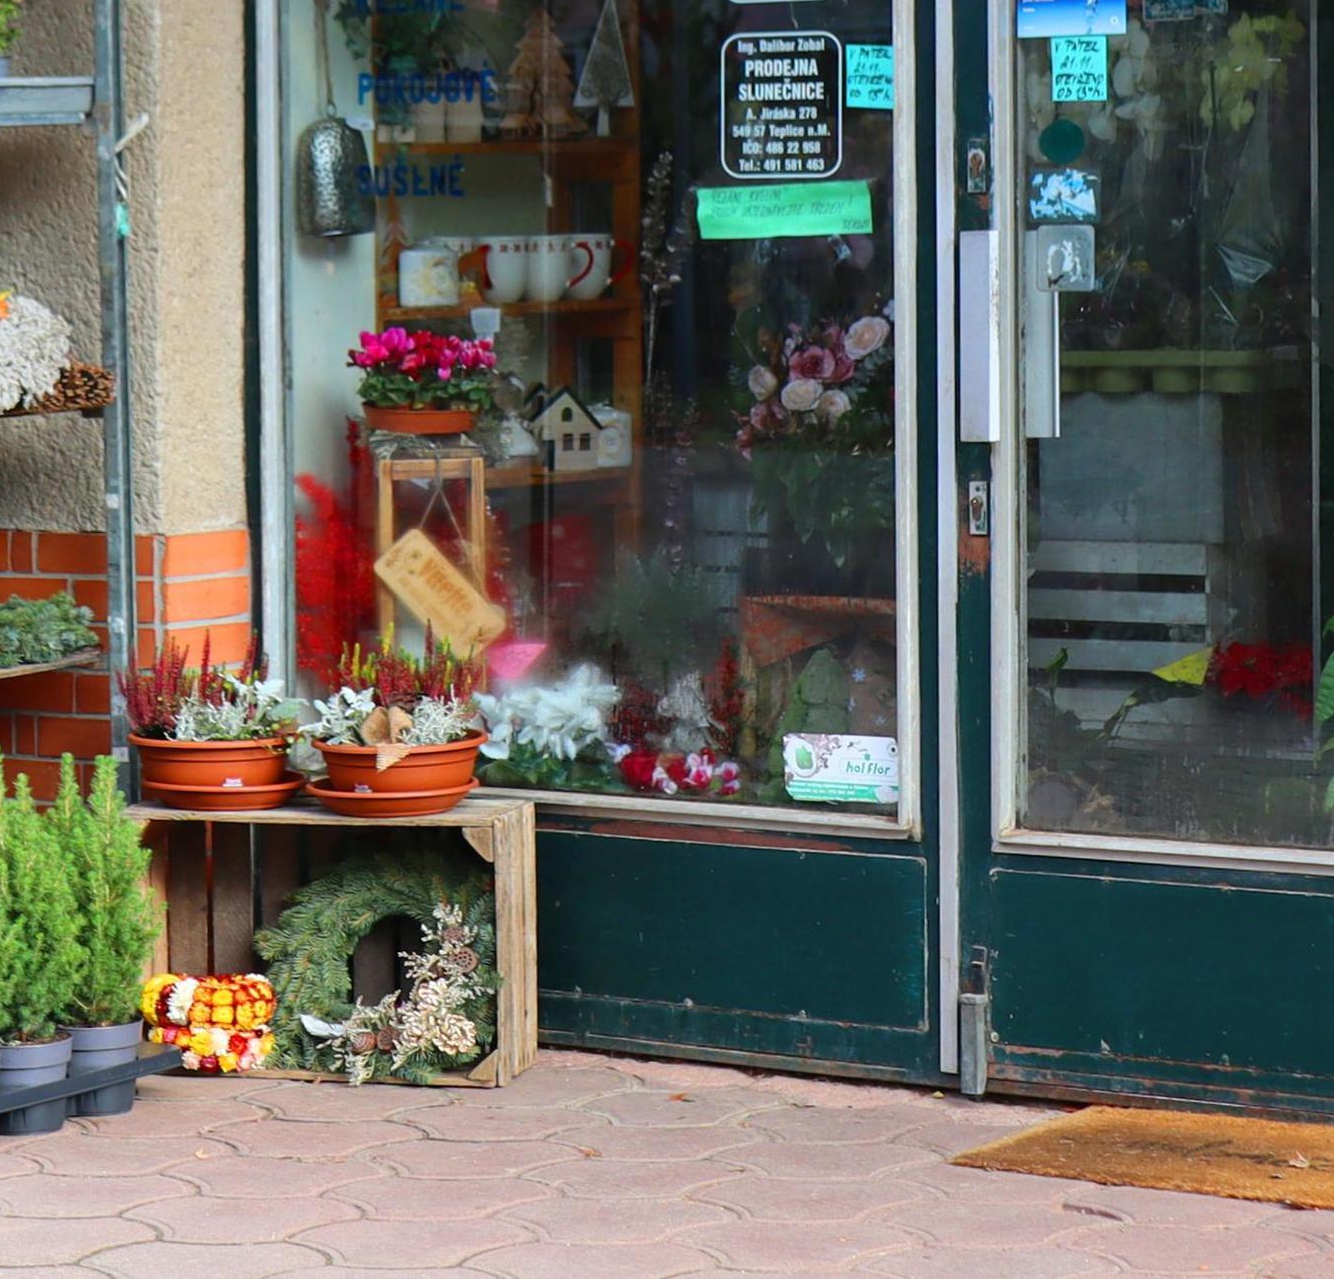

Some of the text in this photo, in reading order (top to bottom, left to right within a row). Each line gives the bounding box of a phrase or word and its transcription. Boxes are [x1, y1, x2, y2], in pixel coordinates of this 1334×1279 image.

[737, 41, 757, 56] Ing.
[759, 39, 795, 53] Dalibor
[745, 58, 819, 77] PRODEJNA
[357, 61, 499, 105] POKOJOVÉ
[738, 78, 825, 101] SLUNEČNICE
[746, 108, 758, 120] A.
[759, 106, 796, 120] Jiráska
[769, 123, 805, 139] Teplice
